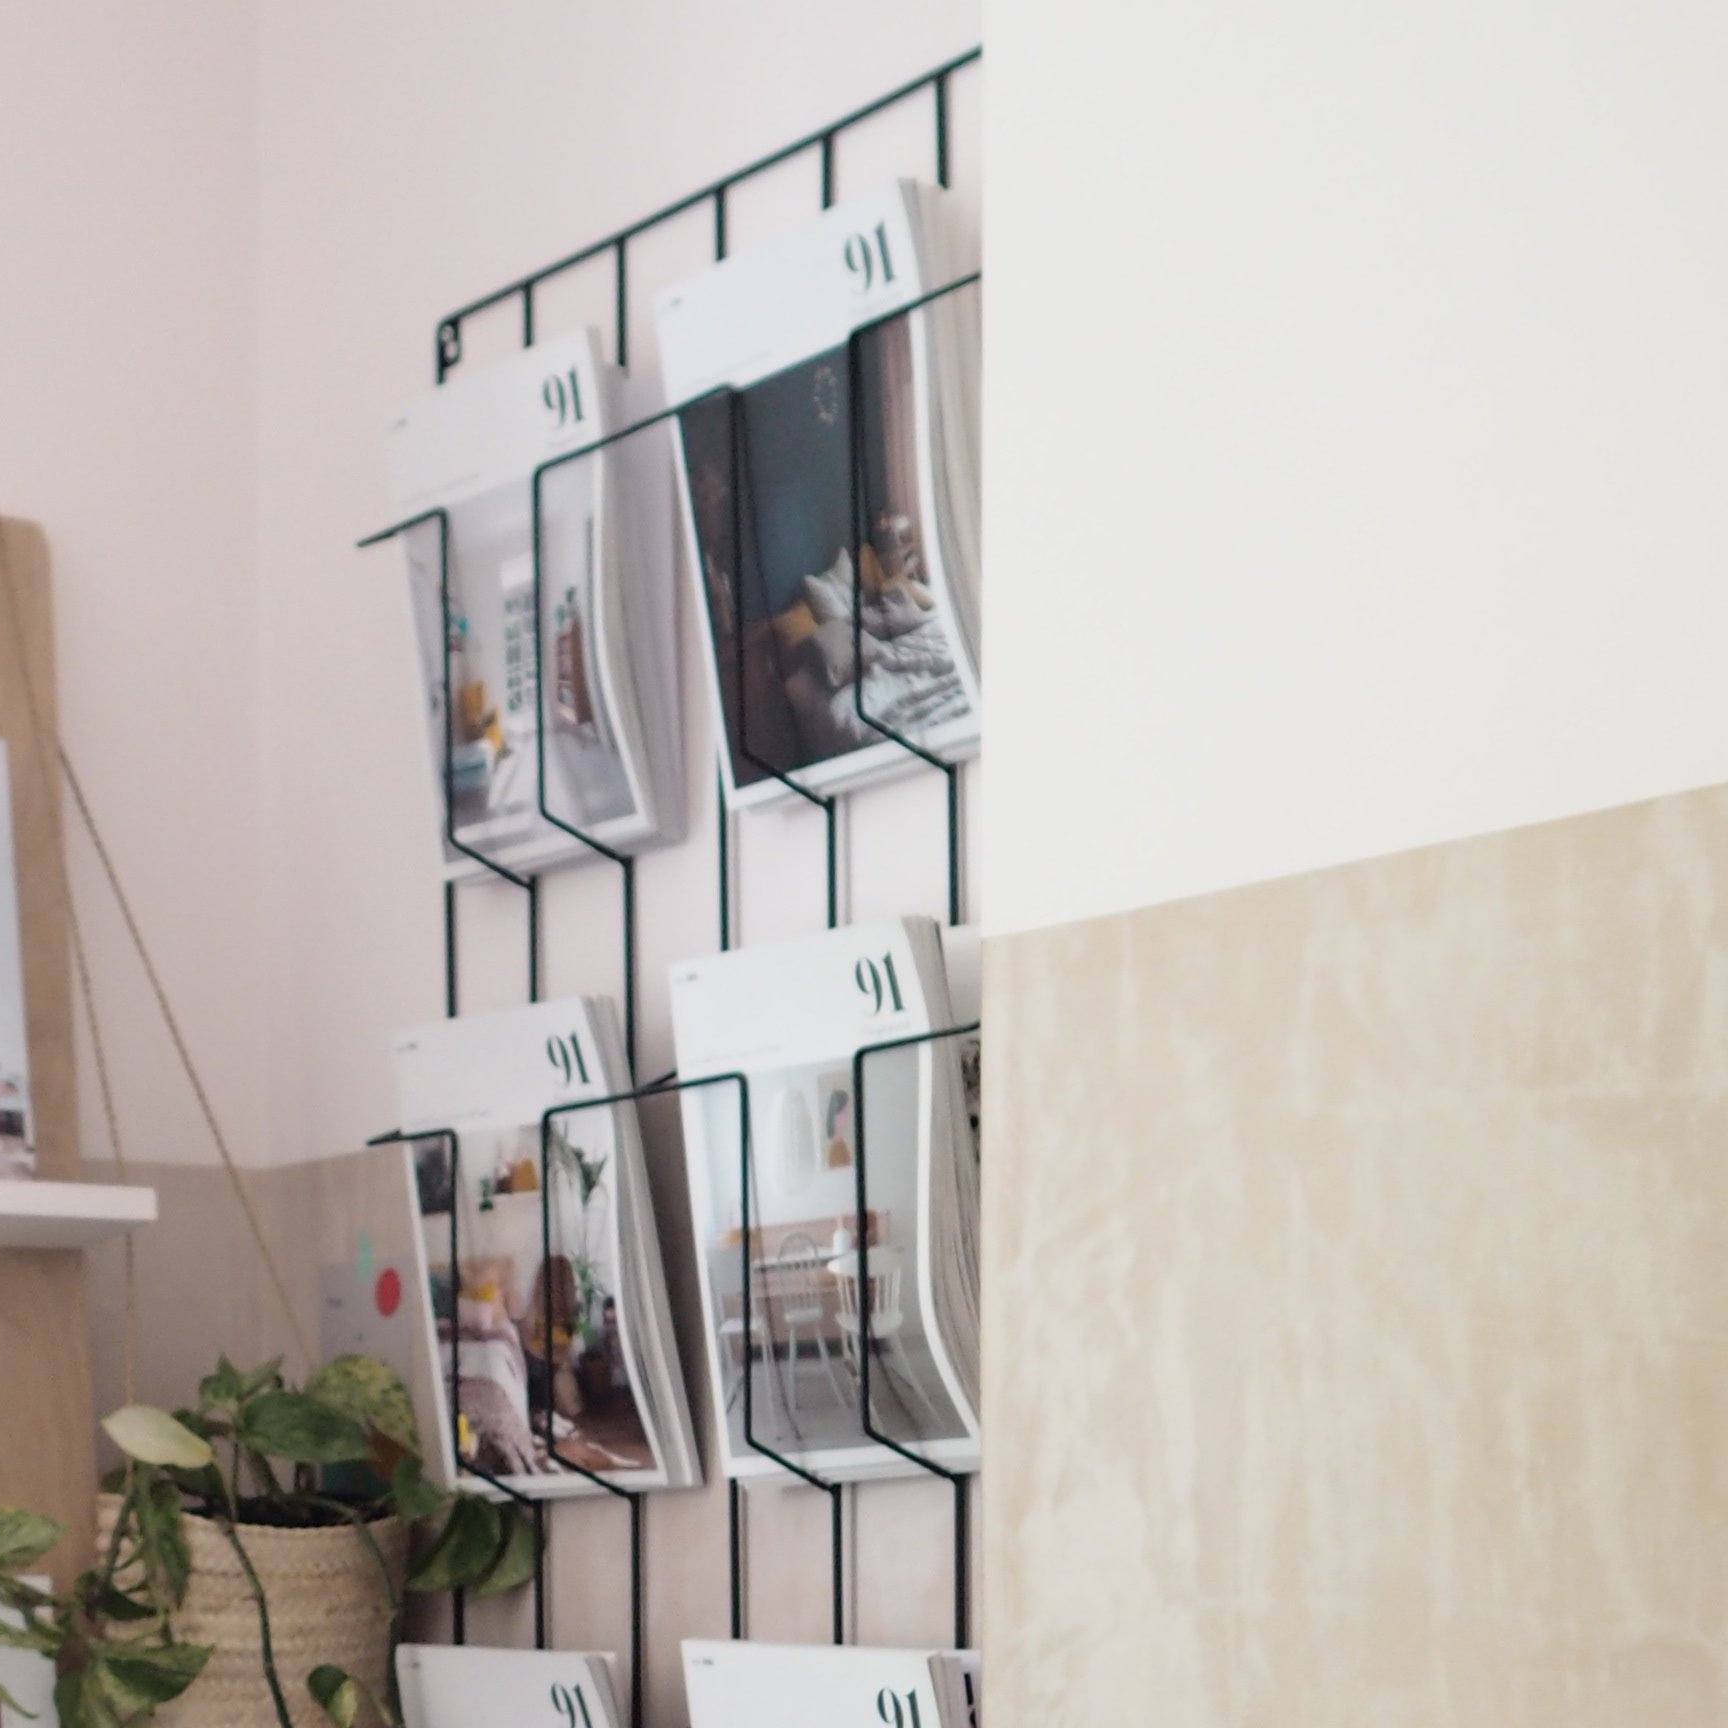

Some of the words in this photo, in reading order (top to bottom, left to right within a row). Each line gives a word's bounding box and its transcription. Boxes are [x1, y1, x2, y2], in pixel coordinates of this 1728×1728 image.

[844, 220, 897, 293] 91
[543, 366, 585, 430] 91
[855, 950, 904, 1015] 91
[546, 1032, 590, 1086] 91
